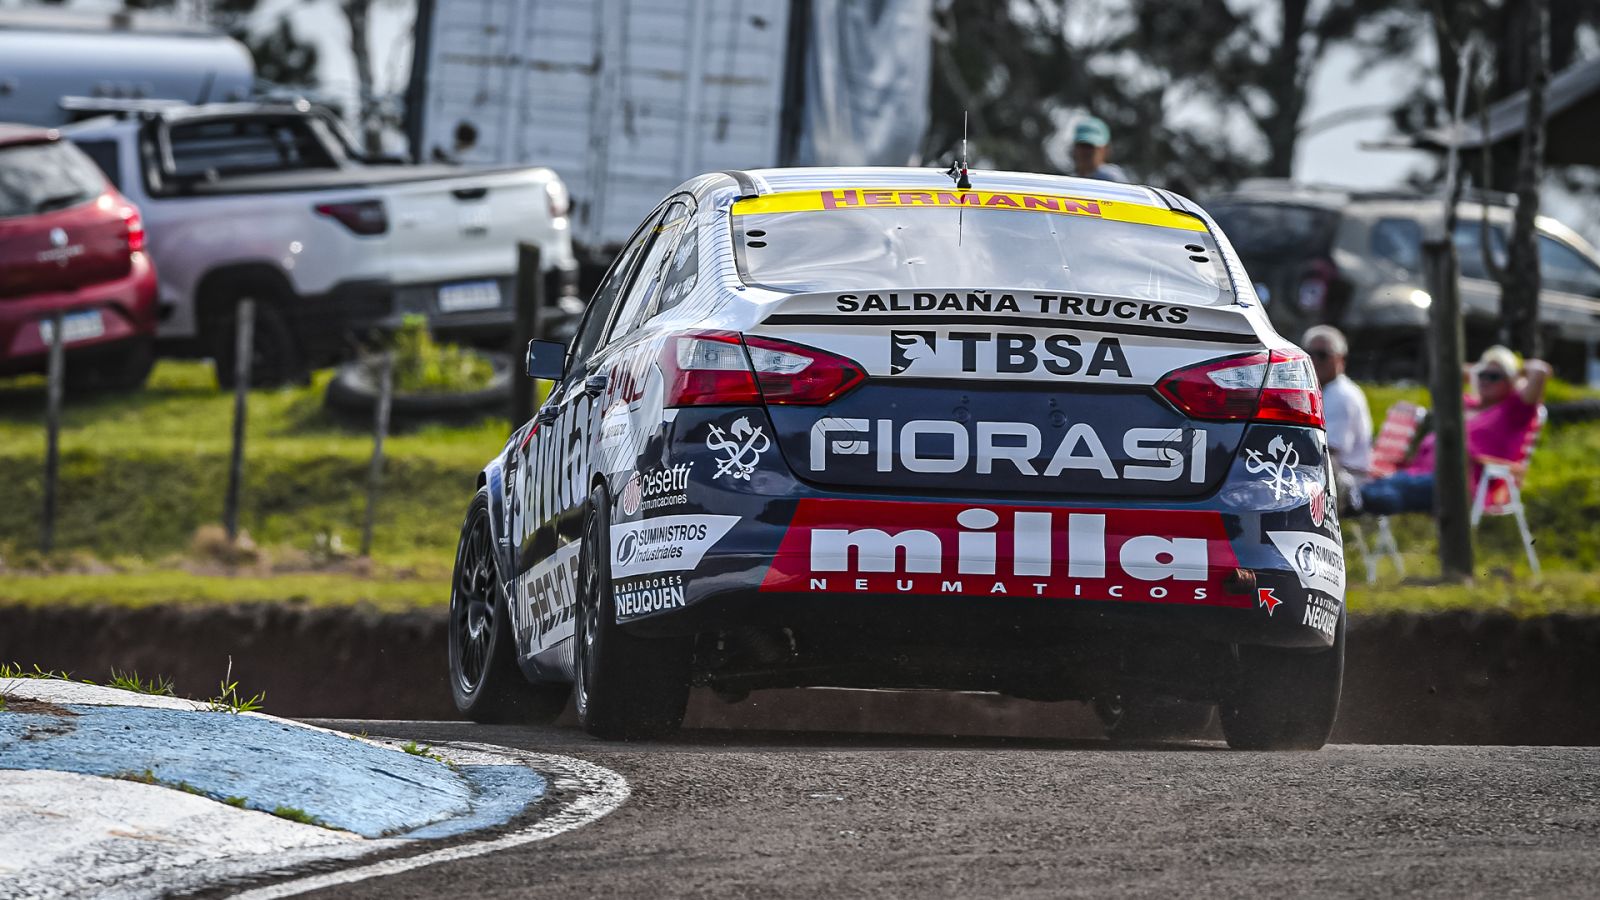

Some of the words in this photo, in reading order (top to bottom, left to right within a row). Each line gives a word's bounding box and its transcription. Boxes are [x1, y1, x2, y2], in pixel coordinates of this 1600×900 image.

[820, 188, 1103, 217] HERMANN
[836, 289, 1021, 313] SALDAÑA
[1033, 295, 1189, 324] TRUCKS
[948, 331, 1133, 378] TBSA
[810, 416, 1207, 484] FIORASI
[641, 461, 695, 498] cesetti
[640, 493, 687, 512] comunicaciones
[638, 524, 708, 546] SUMINISTROS
[810, 508, 1208, 581] milla
[615, 575, 682, 594] RADIADORES
[810, 577, 1208, 600] NEUMATICOS
[616, 586, 686, 616] NEUQUEN
